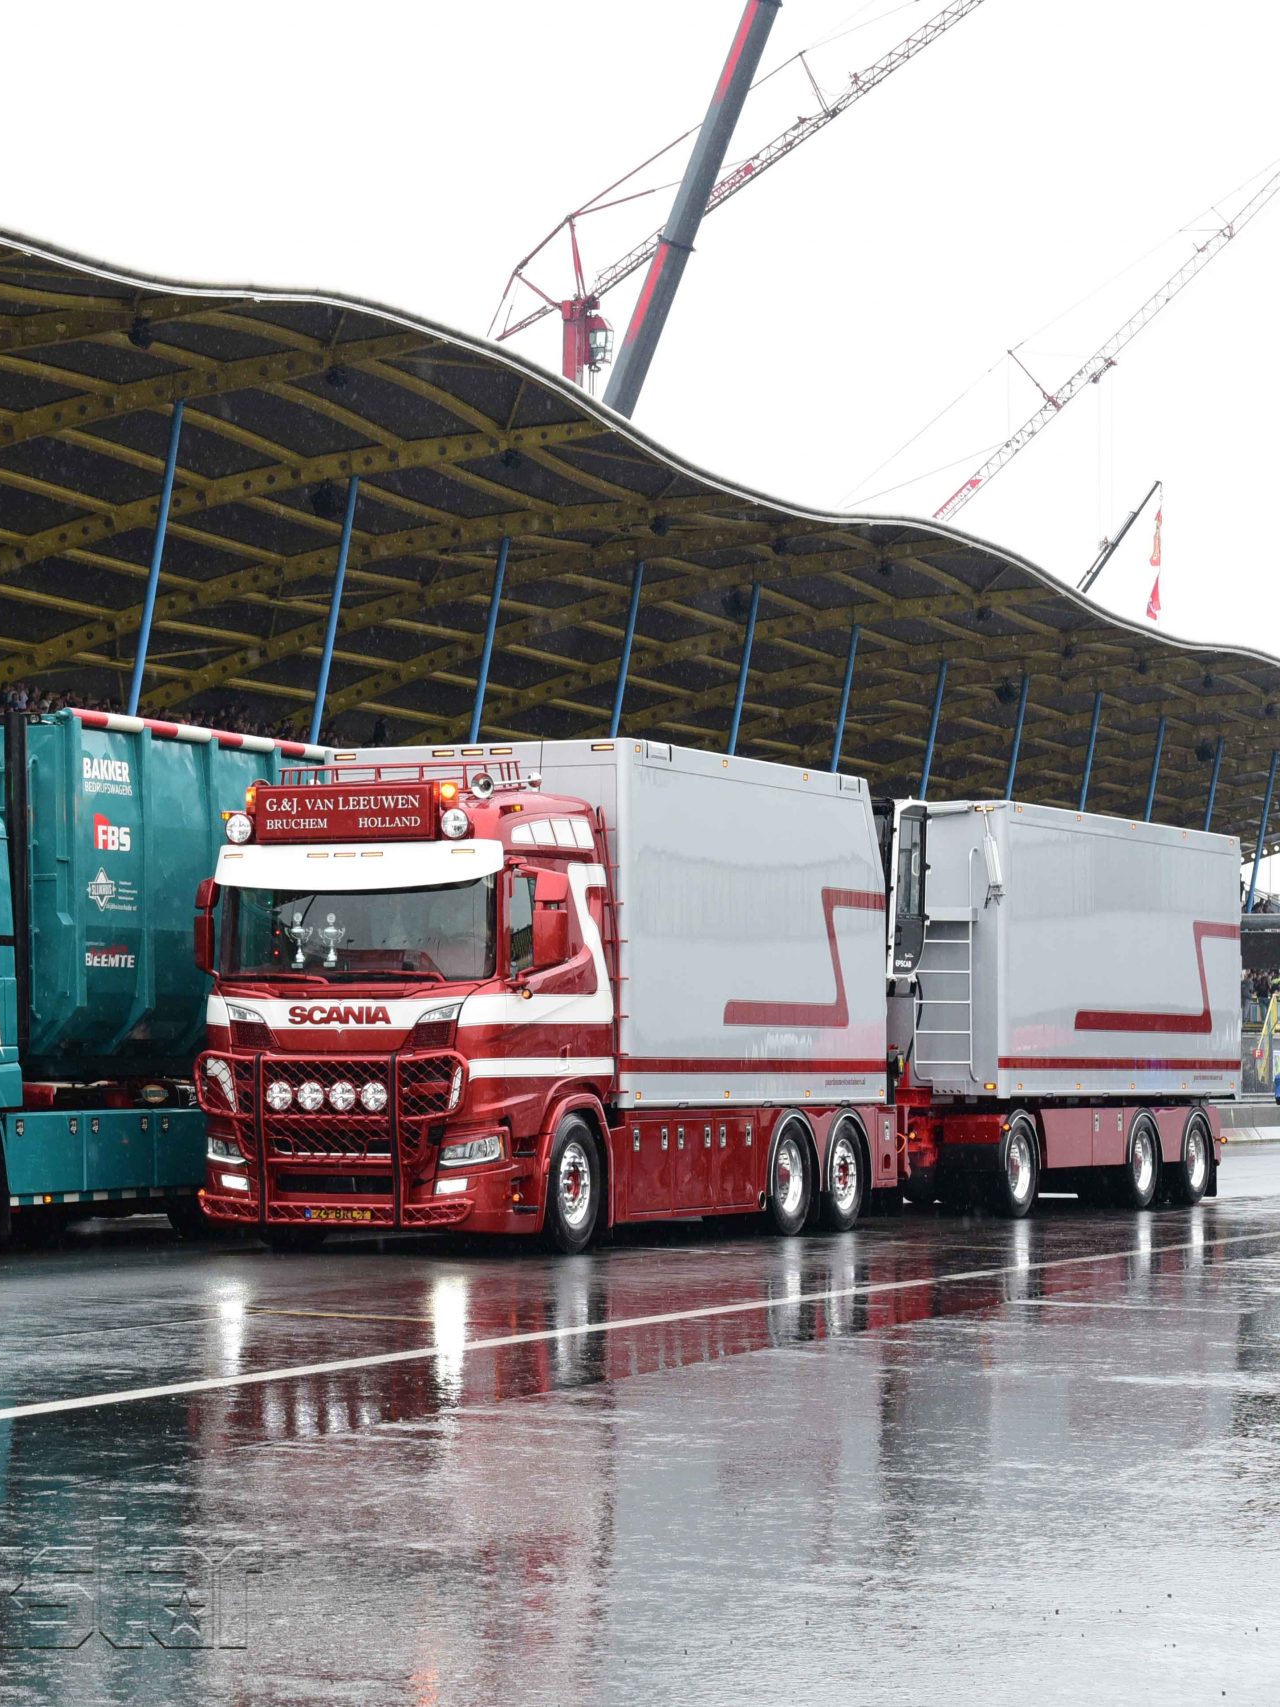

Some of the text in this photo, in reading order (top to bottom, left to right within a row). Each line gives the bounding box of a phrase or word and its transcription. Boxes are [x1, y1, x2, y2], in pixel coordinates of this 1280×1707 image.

[82, 757, 130, 782] BAKKER
[305, 799, 334, 811] VAN
[338, 794, 420, 811] LEEUWEN
[266, 816, 421, 830] BRUCHEM HOLLAND
[97, 825, 131, 852] FBS
[85, 952, 136, 969] BEEMTE
[288, 1005, 392, 1025] SCANIA
